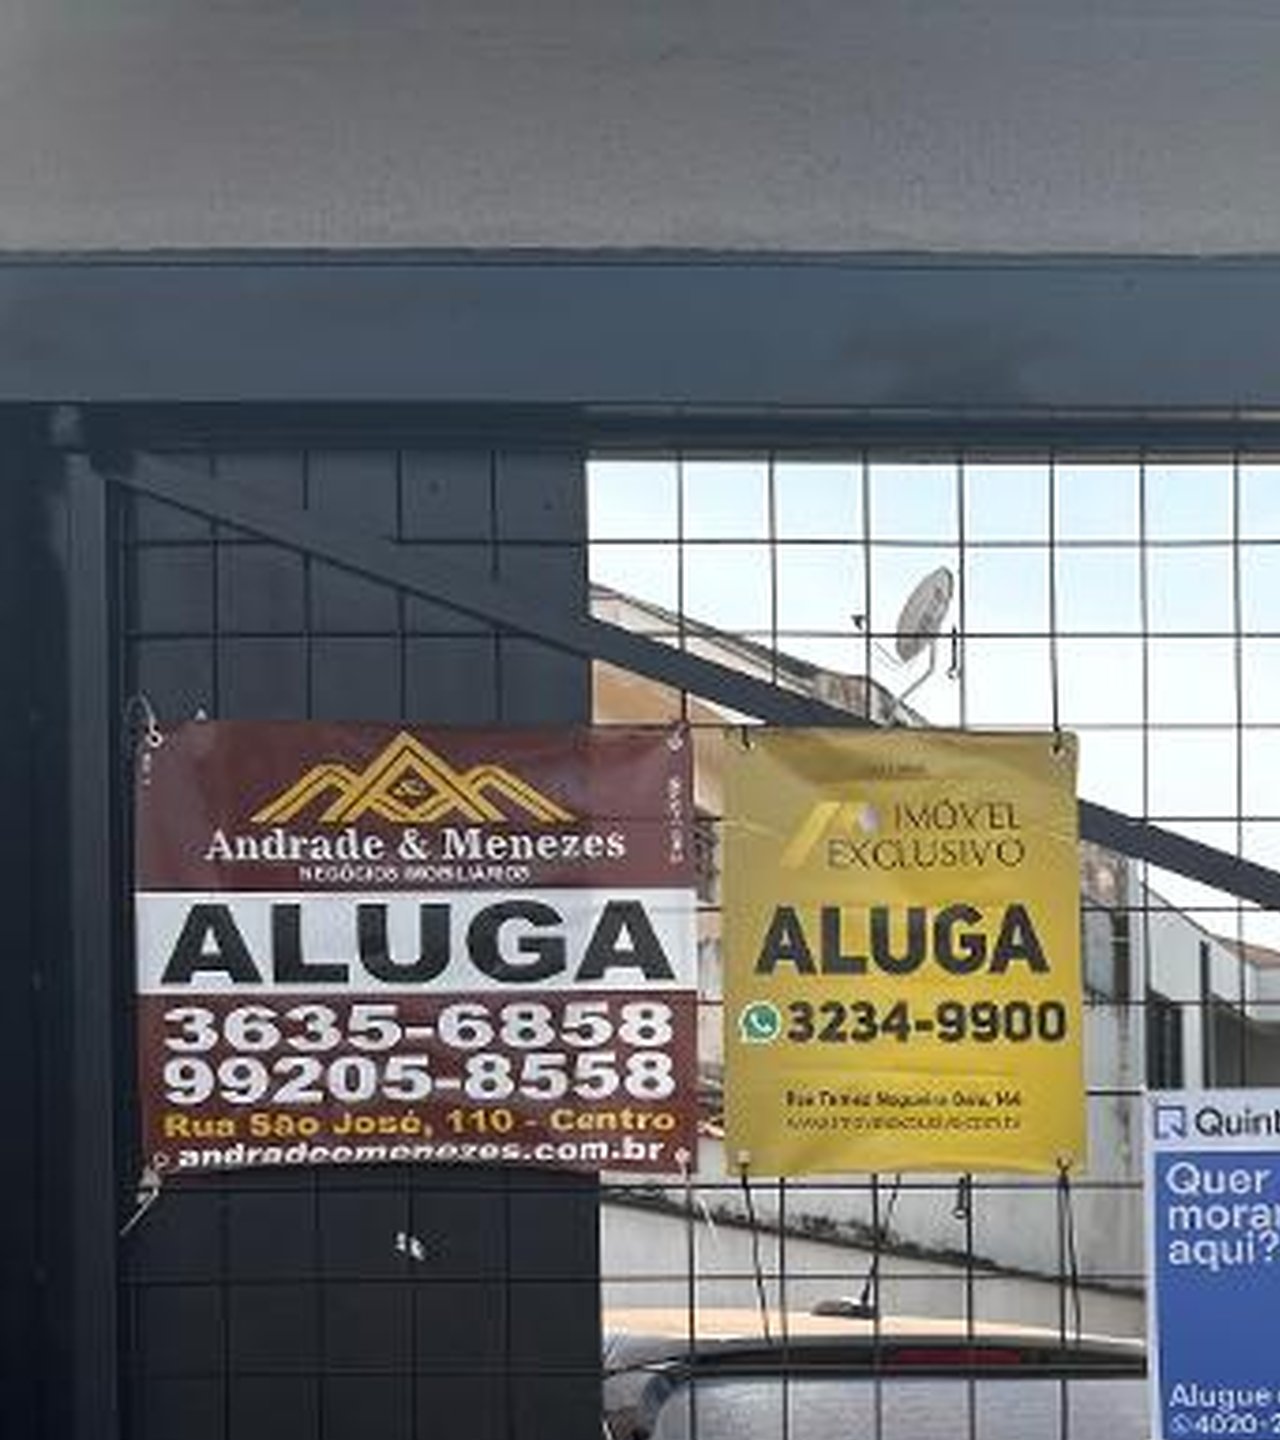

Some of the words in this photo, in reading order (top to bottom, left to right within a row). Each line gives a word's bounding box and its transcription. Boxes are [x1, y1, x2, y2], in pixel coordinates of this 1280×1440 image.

[895, 797, 1021, 831] IMÓVEL
[205, 828, 386, 862] Andrade
[399, 830, 430, 860] &
[441, 827, 627, 861] Menezes
[827, 837, 1026, 872] EXCLUSIVO
[160, 899, 677, 985] ALUGA
[754, 903, 1051, 976] ALUGA
[163, 1002, 675, 1053] 3635-6858
[786, 1001, 1068, 1045] 3234-9900
[162, 1050, 677, 1105] 99205-8558
[164, 1112, 236, 1138] Rua
[250, 1111, 321, 1137] São
[448, 1108, 514, 1134] 110
[551, 1107, 677, 1133] Centro
[1165, 1160, 1272, 1196] Quer
[1168, 1232, 1280, 1271] aqui?
[1169, 1383, 1272, 1413] Alugue
